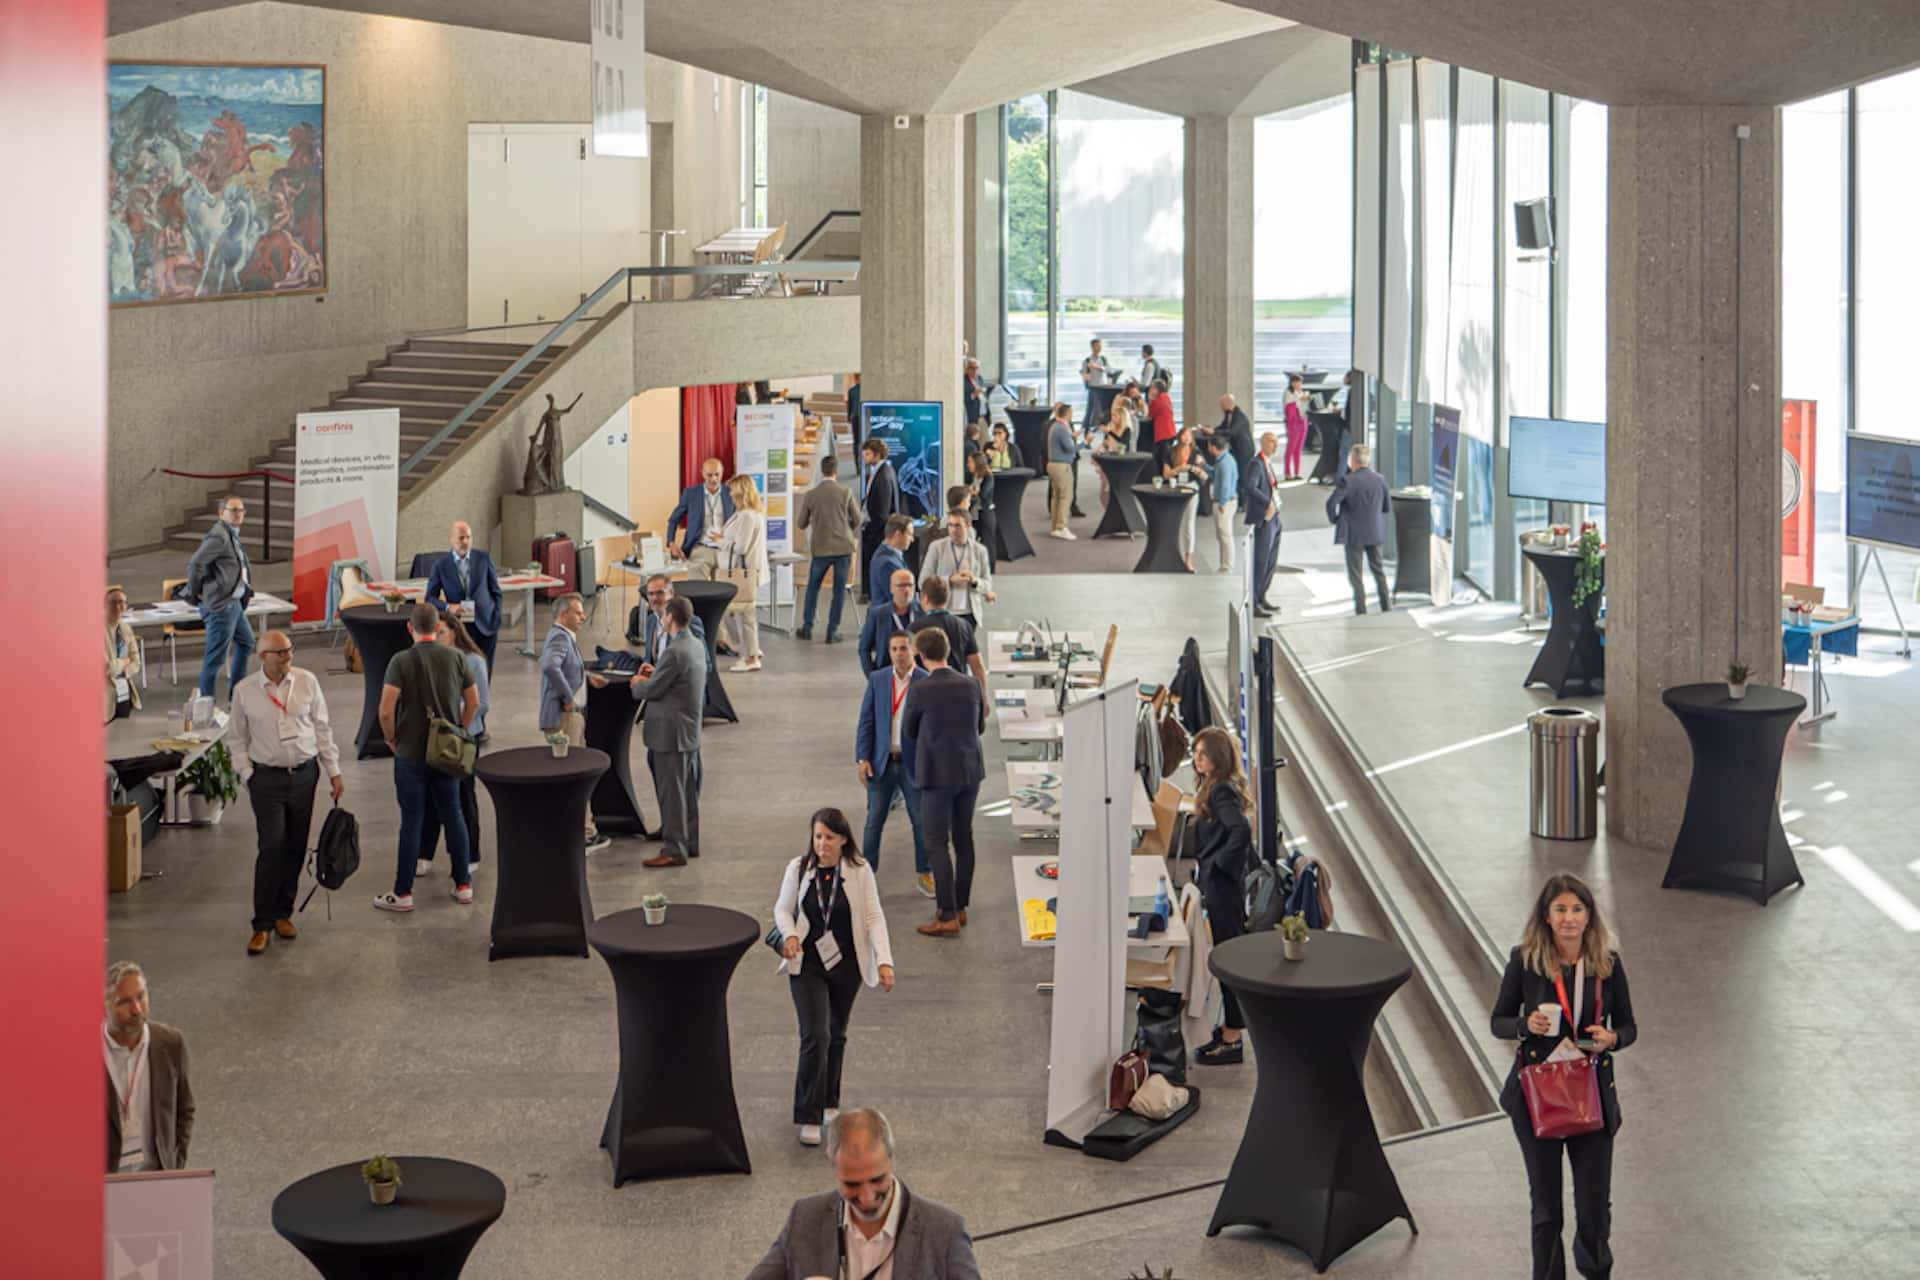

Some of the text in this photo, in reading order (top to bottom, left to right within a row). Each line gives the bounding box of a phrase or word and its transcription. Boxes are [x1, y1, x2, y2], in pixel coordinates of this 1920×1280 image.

[315, 423, 353, 432] confinis
[300, 456, 329, 465] Medical
[332, 455, 362, 463] devices,
[373, 453, 391, 461] vitro
[300, 463, 394, 476] diagnostics, combination
[299, 477, 334, 487] products
